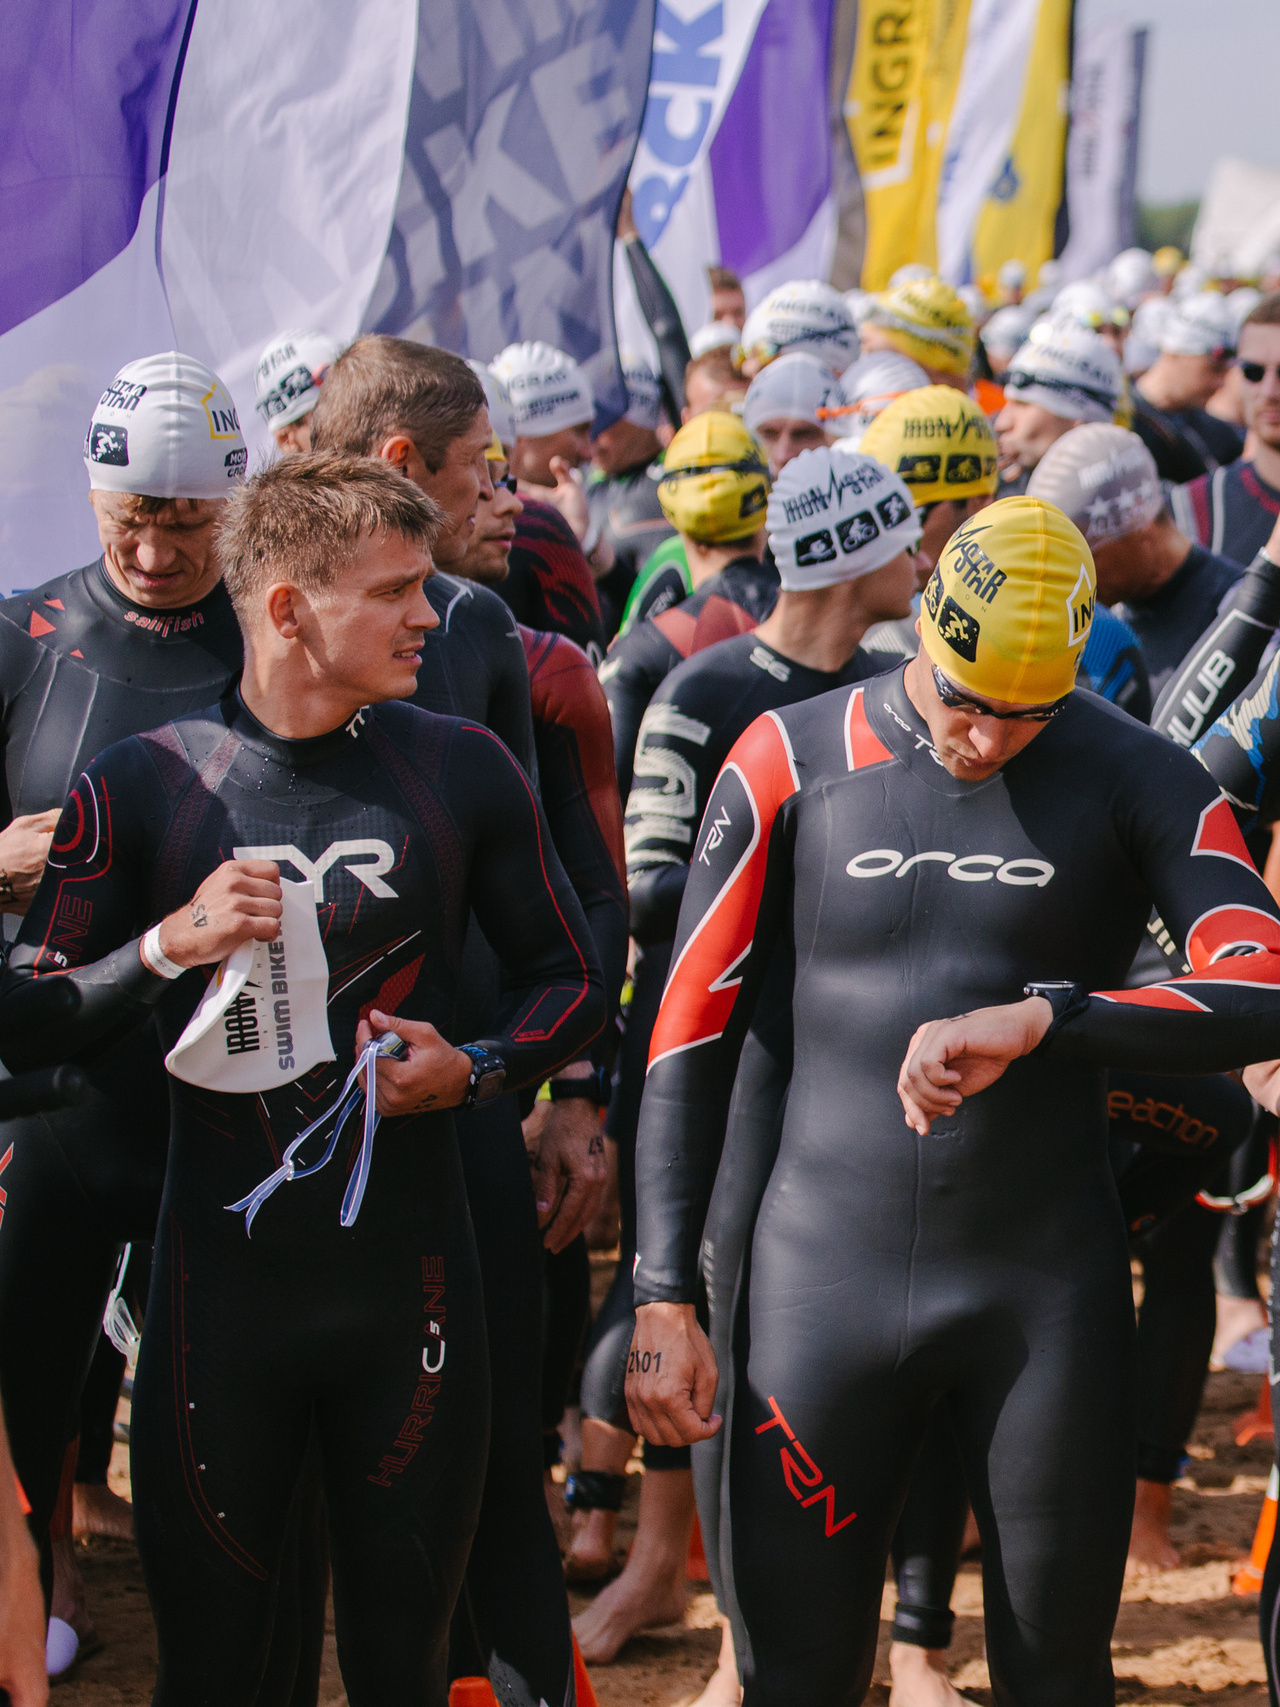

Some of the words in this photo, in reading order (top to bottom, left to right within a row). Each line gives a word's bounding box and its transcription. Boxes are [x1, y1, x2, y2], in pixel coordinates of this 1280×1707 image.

[123, 611, 205, 638] sailfish
[232, 838, 400, 903] TYR
[846, 848, 1056, 887] orca
[267, 941, 289, 995] BIKE
[272, 998, 295, 1071] SWIM
